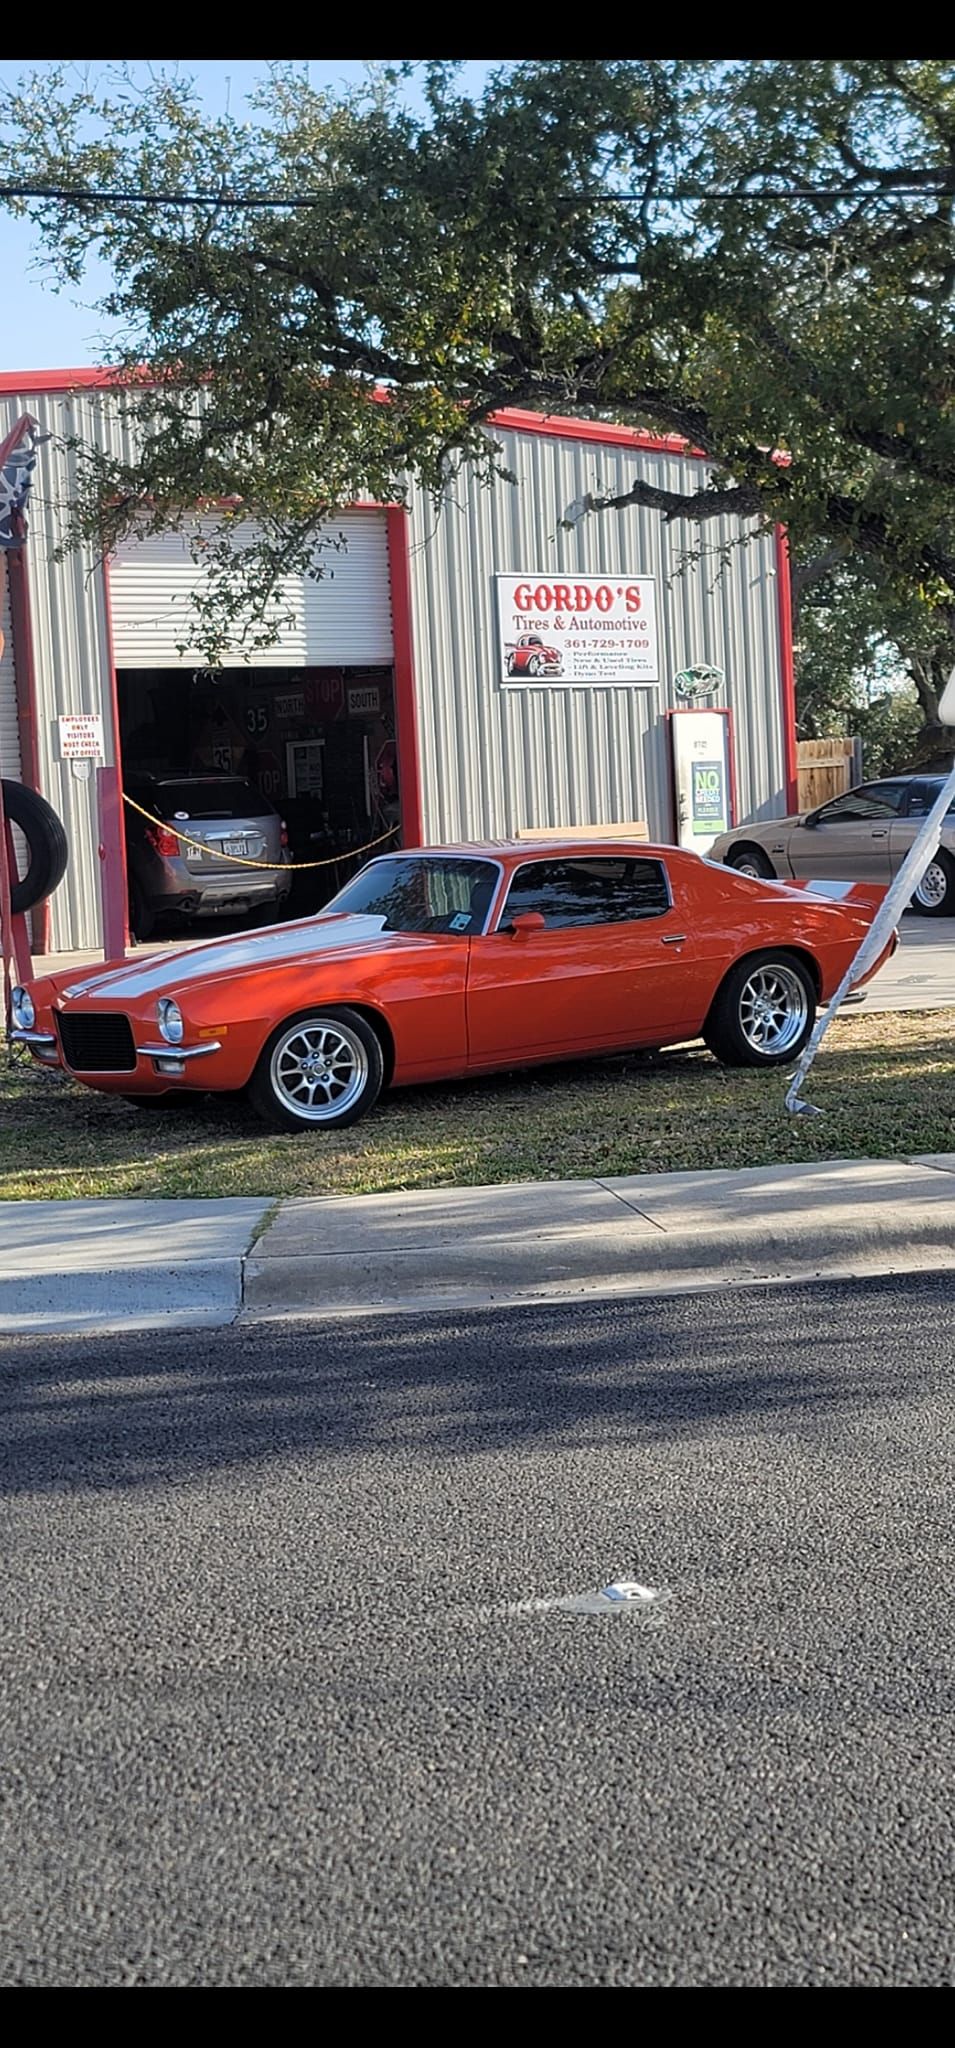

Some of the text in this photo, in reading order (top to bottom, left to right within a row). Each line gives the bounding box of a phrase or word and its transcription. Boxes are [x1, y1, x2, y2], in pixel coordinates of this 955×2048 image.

[513, 584, 642, 613] GORDO'S
[512, 615, 648, 631] Tires & Automotive
[564, 639, 650, 649] 361-729-1709
[306, 680, 340, 704] STOP
[350, 692, 378, 709] SOUTH
[247, 708, 268, 733] 35
[257, 770, 281, 795] TOP
[695, 770, 720, 789] NO
